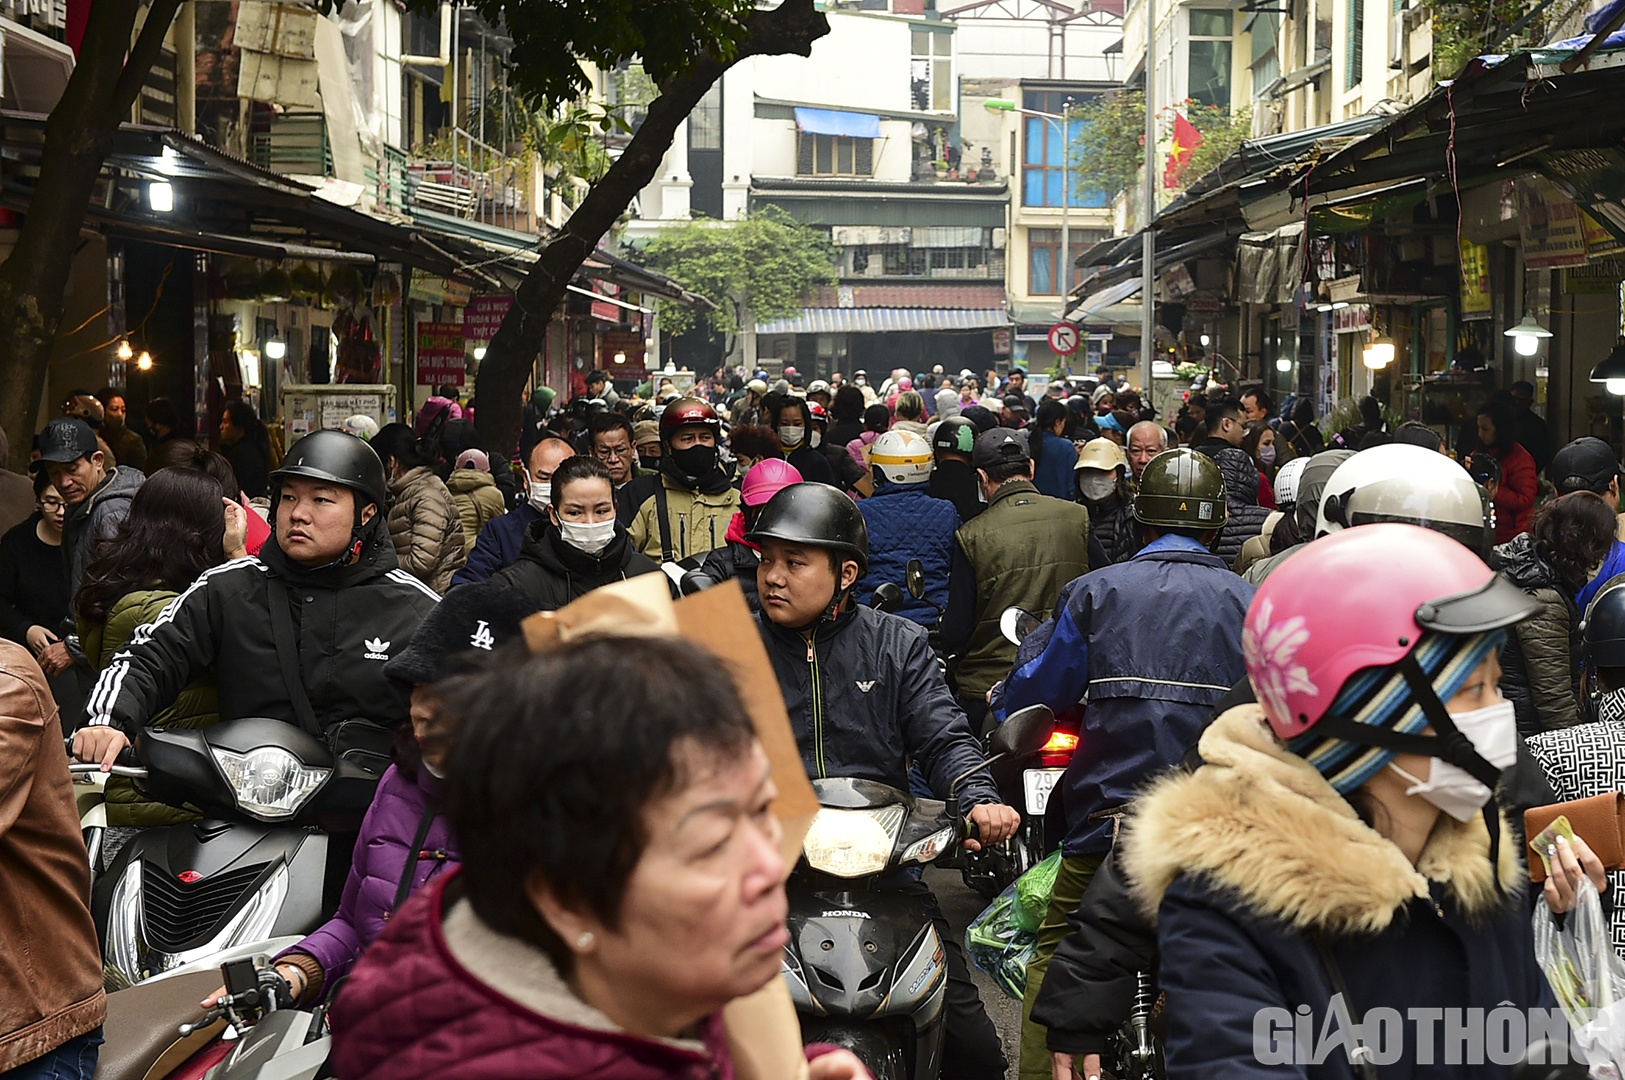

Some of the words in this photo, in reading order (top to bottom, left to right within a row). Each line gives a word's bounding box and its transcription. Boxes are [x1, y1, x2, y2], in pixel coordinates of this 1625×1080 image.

[470, 619, 495, 650] LA
[364, 653, 389, 661] adidas
[822, 910, 872, 919] HONDA
